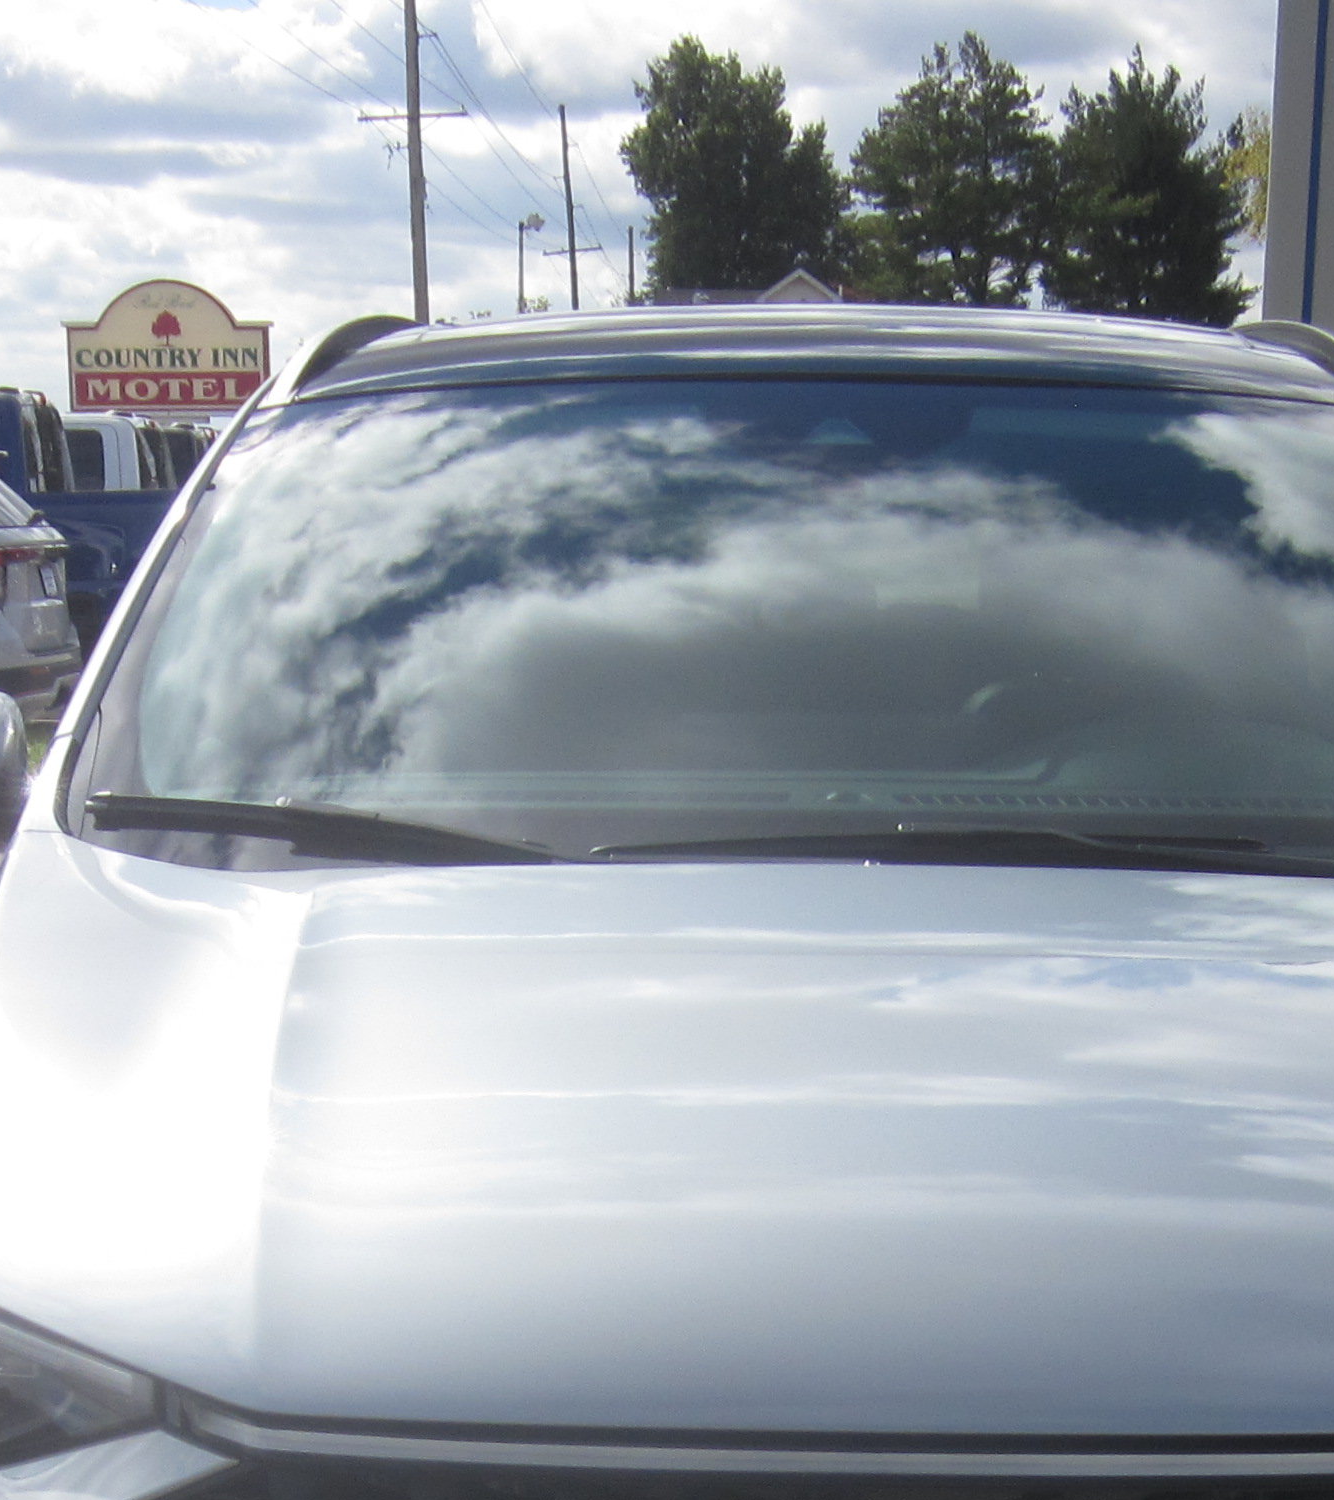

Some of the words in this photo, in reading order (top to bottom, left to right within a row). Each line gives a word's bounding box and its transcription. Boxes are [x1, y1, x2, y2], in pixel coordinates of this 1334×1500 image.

[75, 347, 202, 369] COUNTRY
[212, 346, 258, 368] INN
[87, 377, 250, 401] MOTEL
